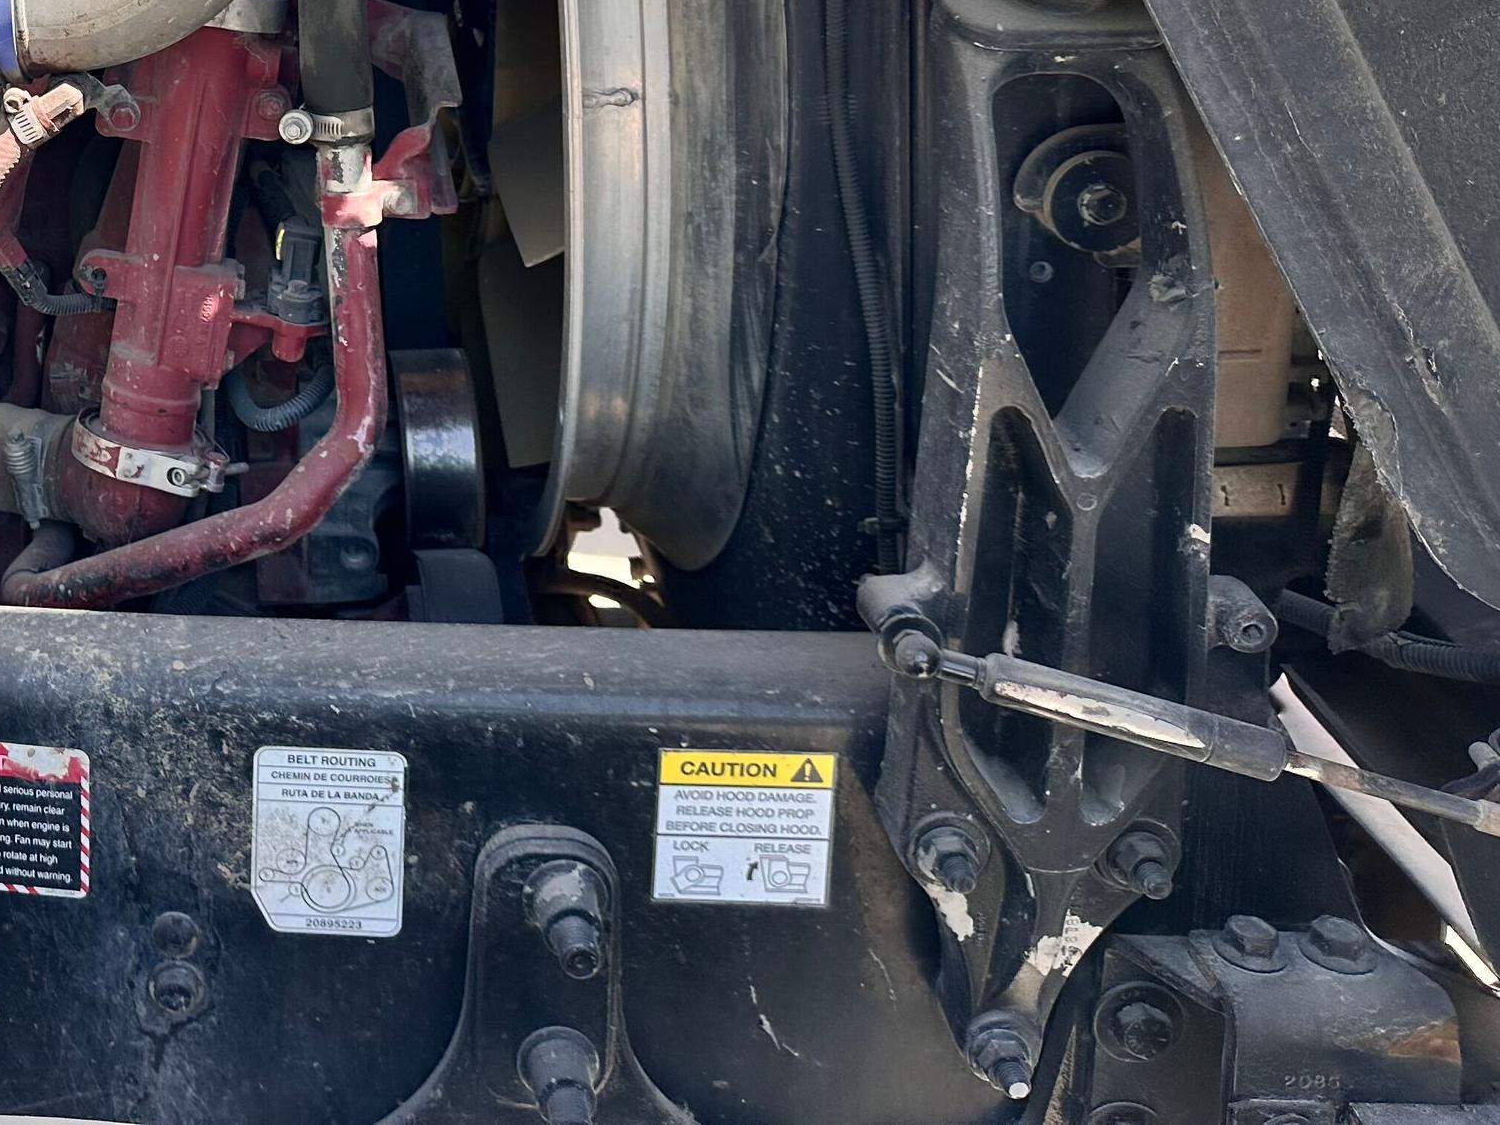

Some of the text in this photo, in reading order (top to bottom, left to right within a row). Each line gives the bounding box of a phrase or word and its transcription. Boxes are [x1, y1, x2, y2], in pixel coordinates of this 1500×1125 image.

[287, 754, 376, 768] BELT ROUTING
[680, 761, 777, 778] CAUTION
[271, 771, 389, 784] CHEMIN DE COURROIES
[3, 786, 34, 797] serious
[35, 788, 73, 800] personal
[281, 789, 379, 802] RUTA DE LA BANDA
[674, 790, 816, 804] AVOID HOOD DAMAGE.
[12, 803, 42, 813] remain
[43, 805, 65, 816] clear
[676, 806, 814, 820] RELEASE HOOD PROP
[6, 818, 30, 828] when
[31, 821, 61, 833] engine
[61, 824, 70, 833] is
[666, 821, 822, 835] BEFORE CLOSING HOOD.
[14, 834, 31, 846] Fan
[32, 838, 51, 849] may
[52, 839, 73, 850] start
[673, 840, 811, 854] LOCK RELEASE
[3, 851, 28, 862] rotate
[28, 854, 38, 863] at
[39, 855, 58, 866] high
[4, 867, 36, 878] without
[36, 871, 73, 884] warning.
